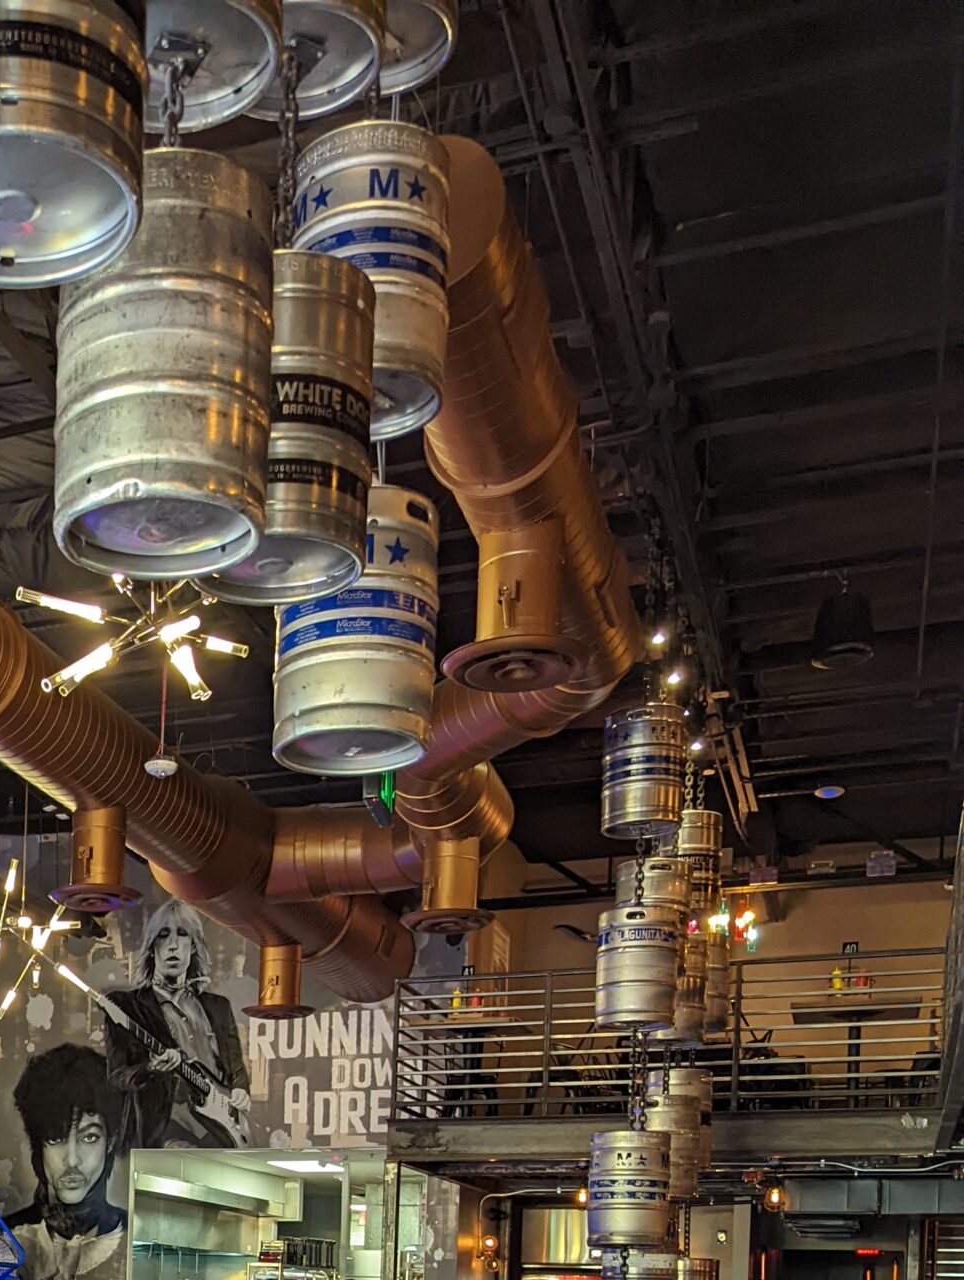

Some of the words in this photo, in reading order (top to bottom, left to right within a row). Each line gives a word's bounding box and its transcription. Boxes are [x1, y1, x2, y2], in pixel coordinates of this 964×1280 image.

[369, 168, 399, 198] M
[276, 381, 343, 411] WHITE
[346, 394, 370, 421] DO
[282, 403, 333, 418] BREWING
[283, 1075, 308, 1124] A
